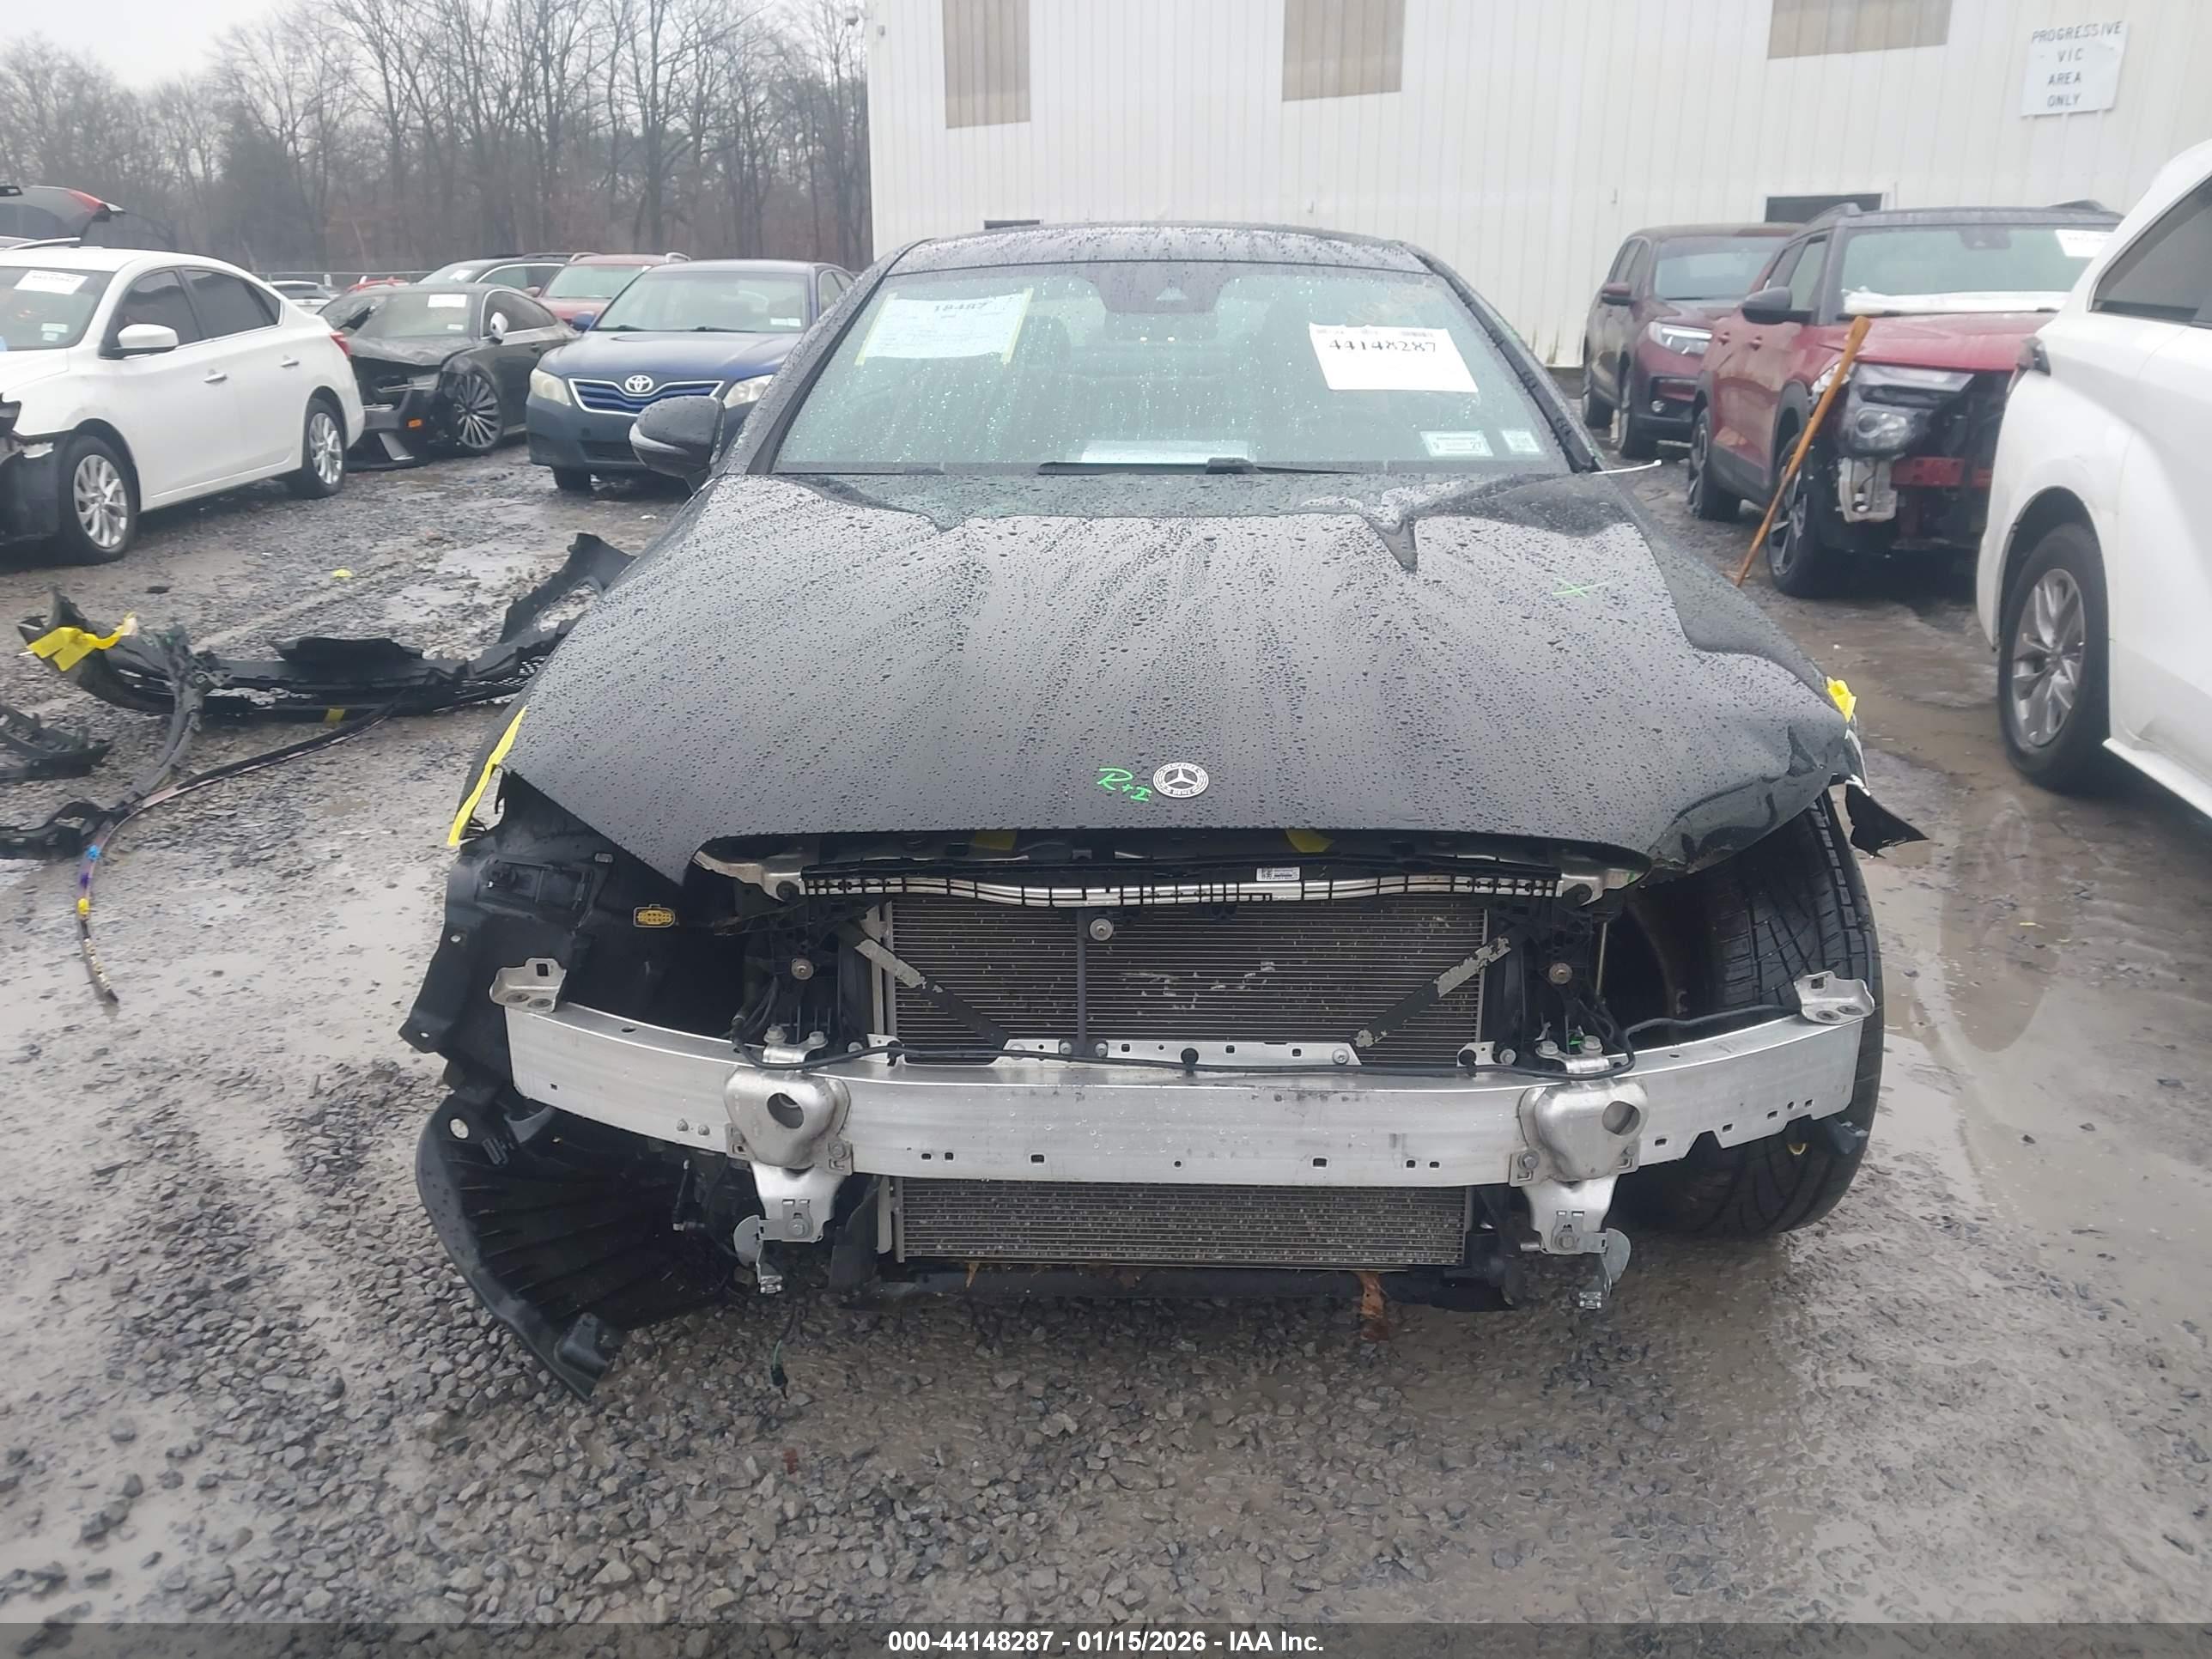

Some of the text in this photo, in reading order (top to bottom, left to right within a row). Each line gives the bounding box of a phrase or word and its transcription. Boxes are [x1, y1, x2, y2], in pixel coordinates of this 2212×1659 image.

[2032, 21, 2122, 42] PROGRESSIVE
[2057, 48, 2083, 62] VIC
[2048, 71, 2081, 86] AREA
[2047, 94, 2081, 107] ONLY
[1329, 339, 1435, 352] 44148287
